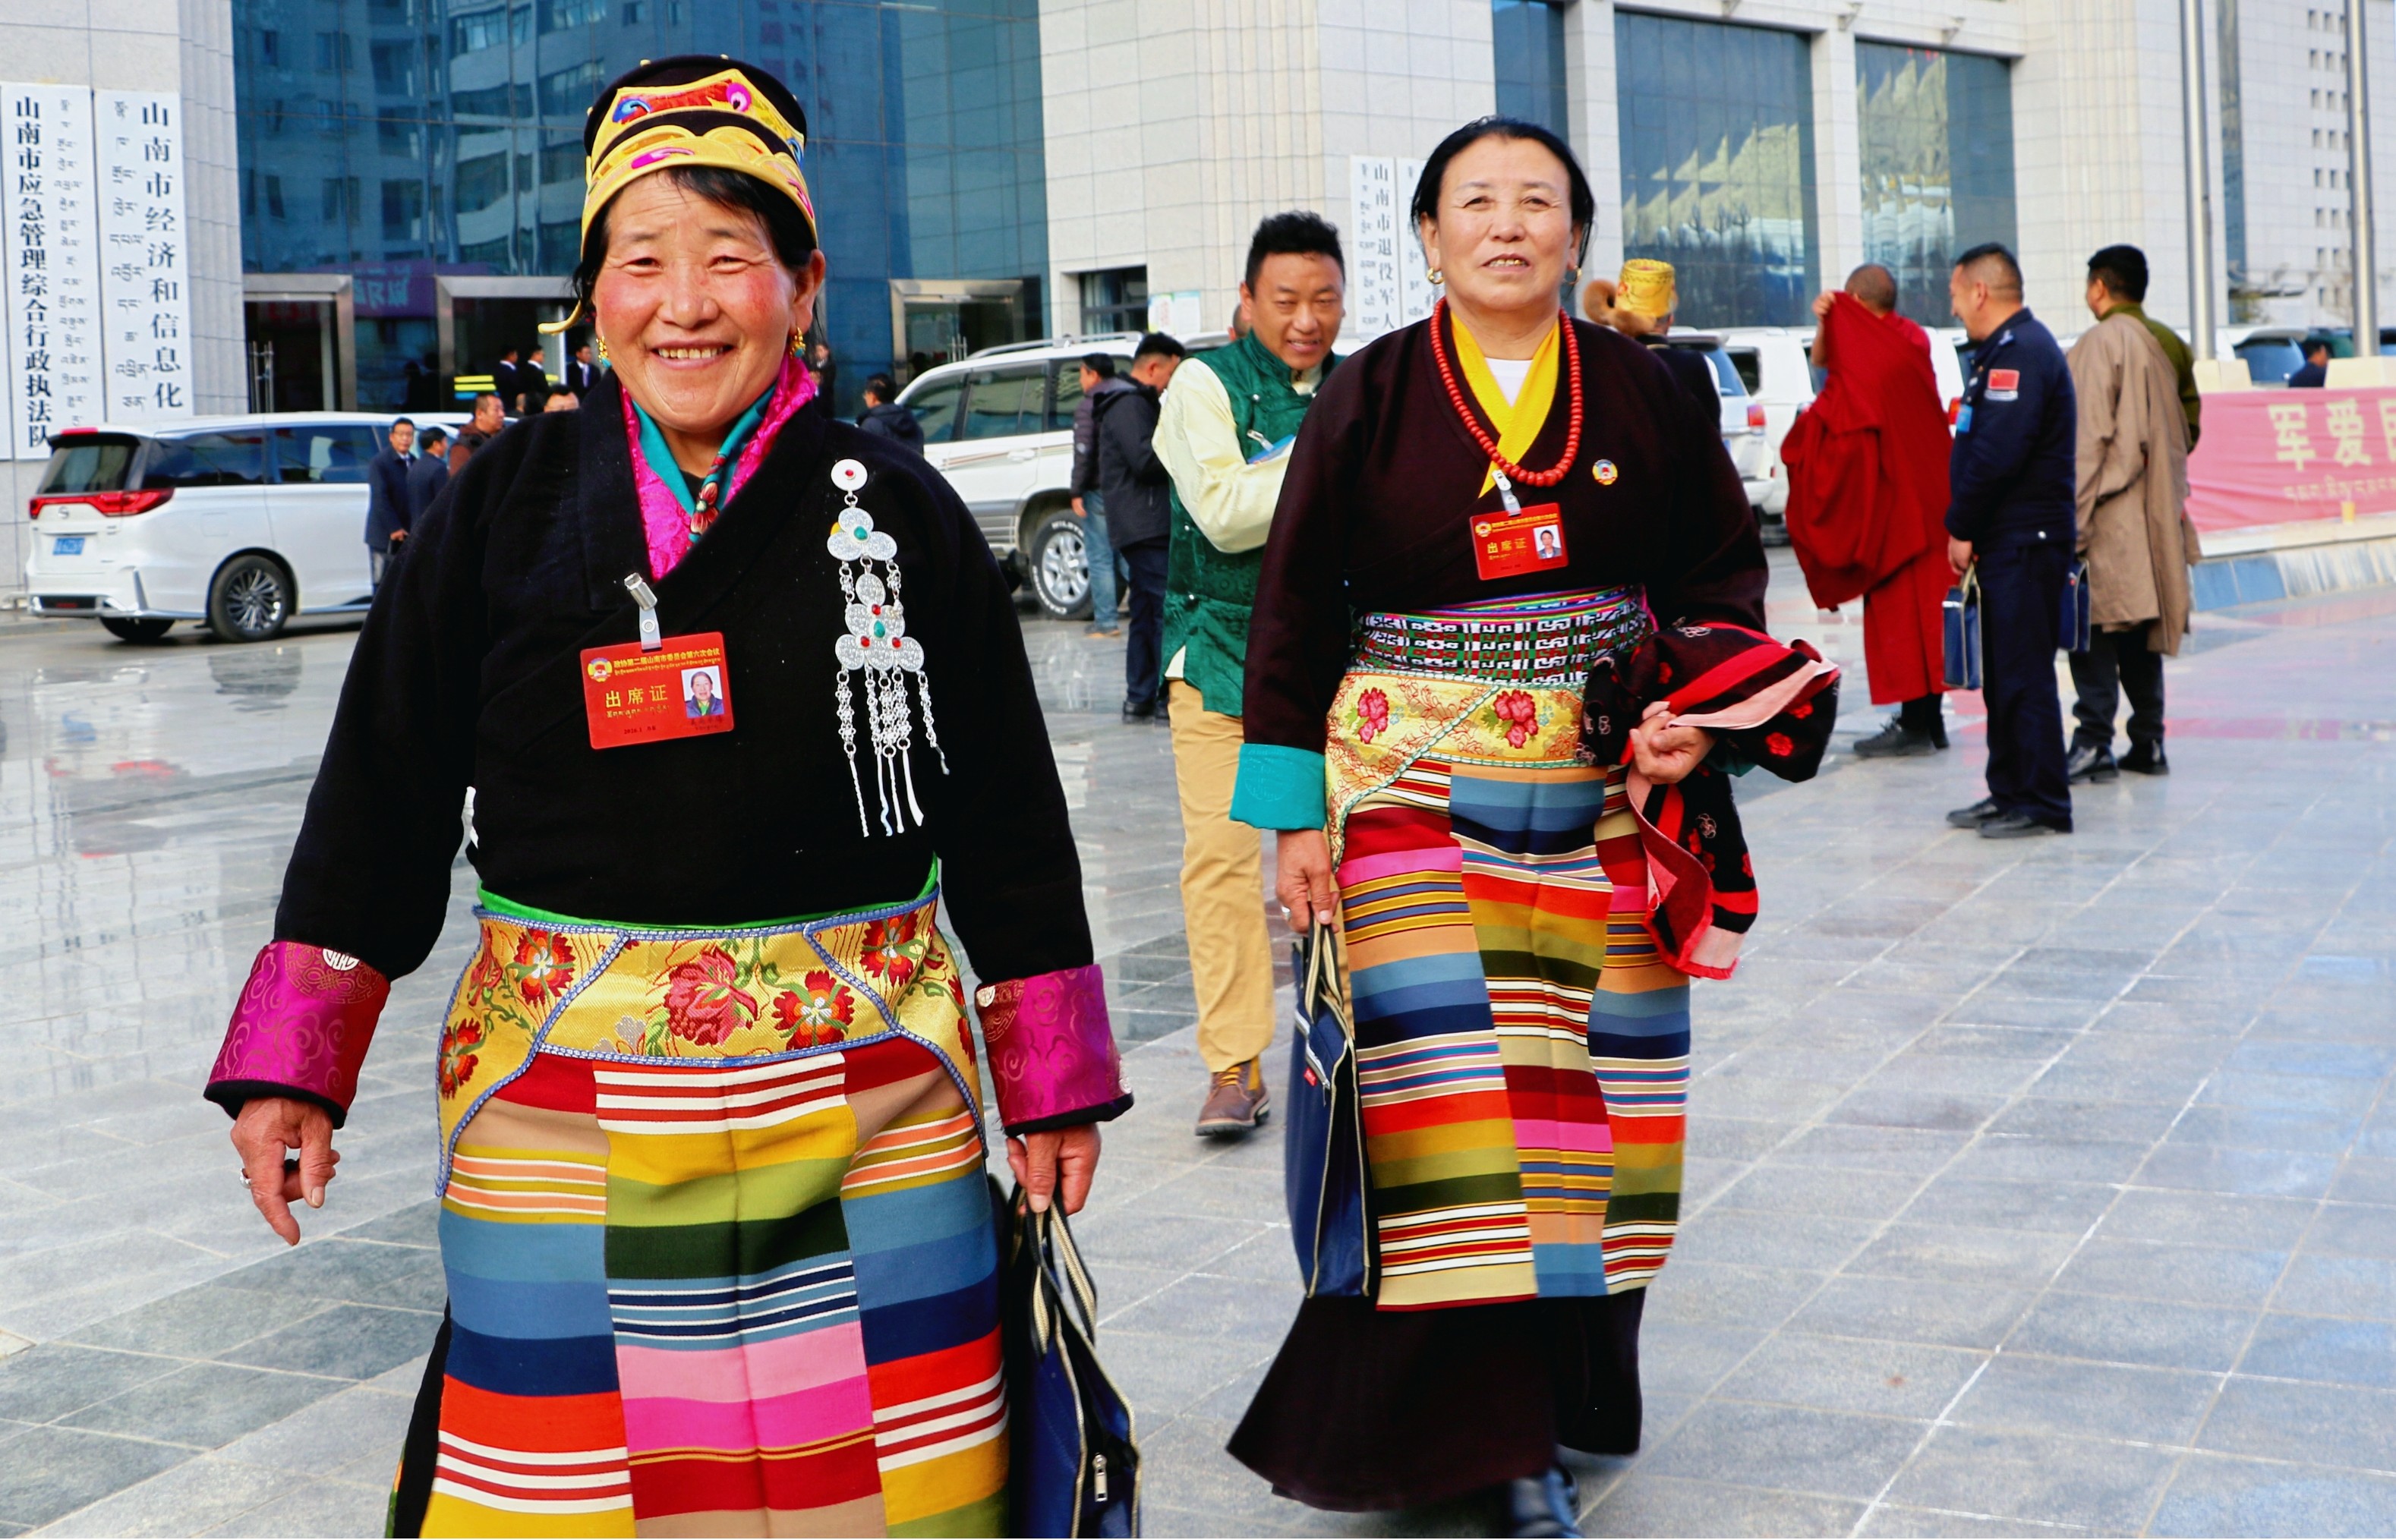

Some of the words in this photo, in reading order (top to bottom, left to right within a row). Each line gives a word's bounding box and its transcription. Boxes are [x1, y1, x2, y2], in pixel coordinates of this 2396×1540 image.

[16, 96, 52, 449] 山南市应急管理综合行政执法队
[142, 101, 184, 410] 山南市经济和信息化
[1374, 163, 1395, 330] 山南市退役军人
[605, 685, 668, 708] 出席证
